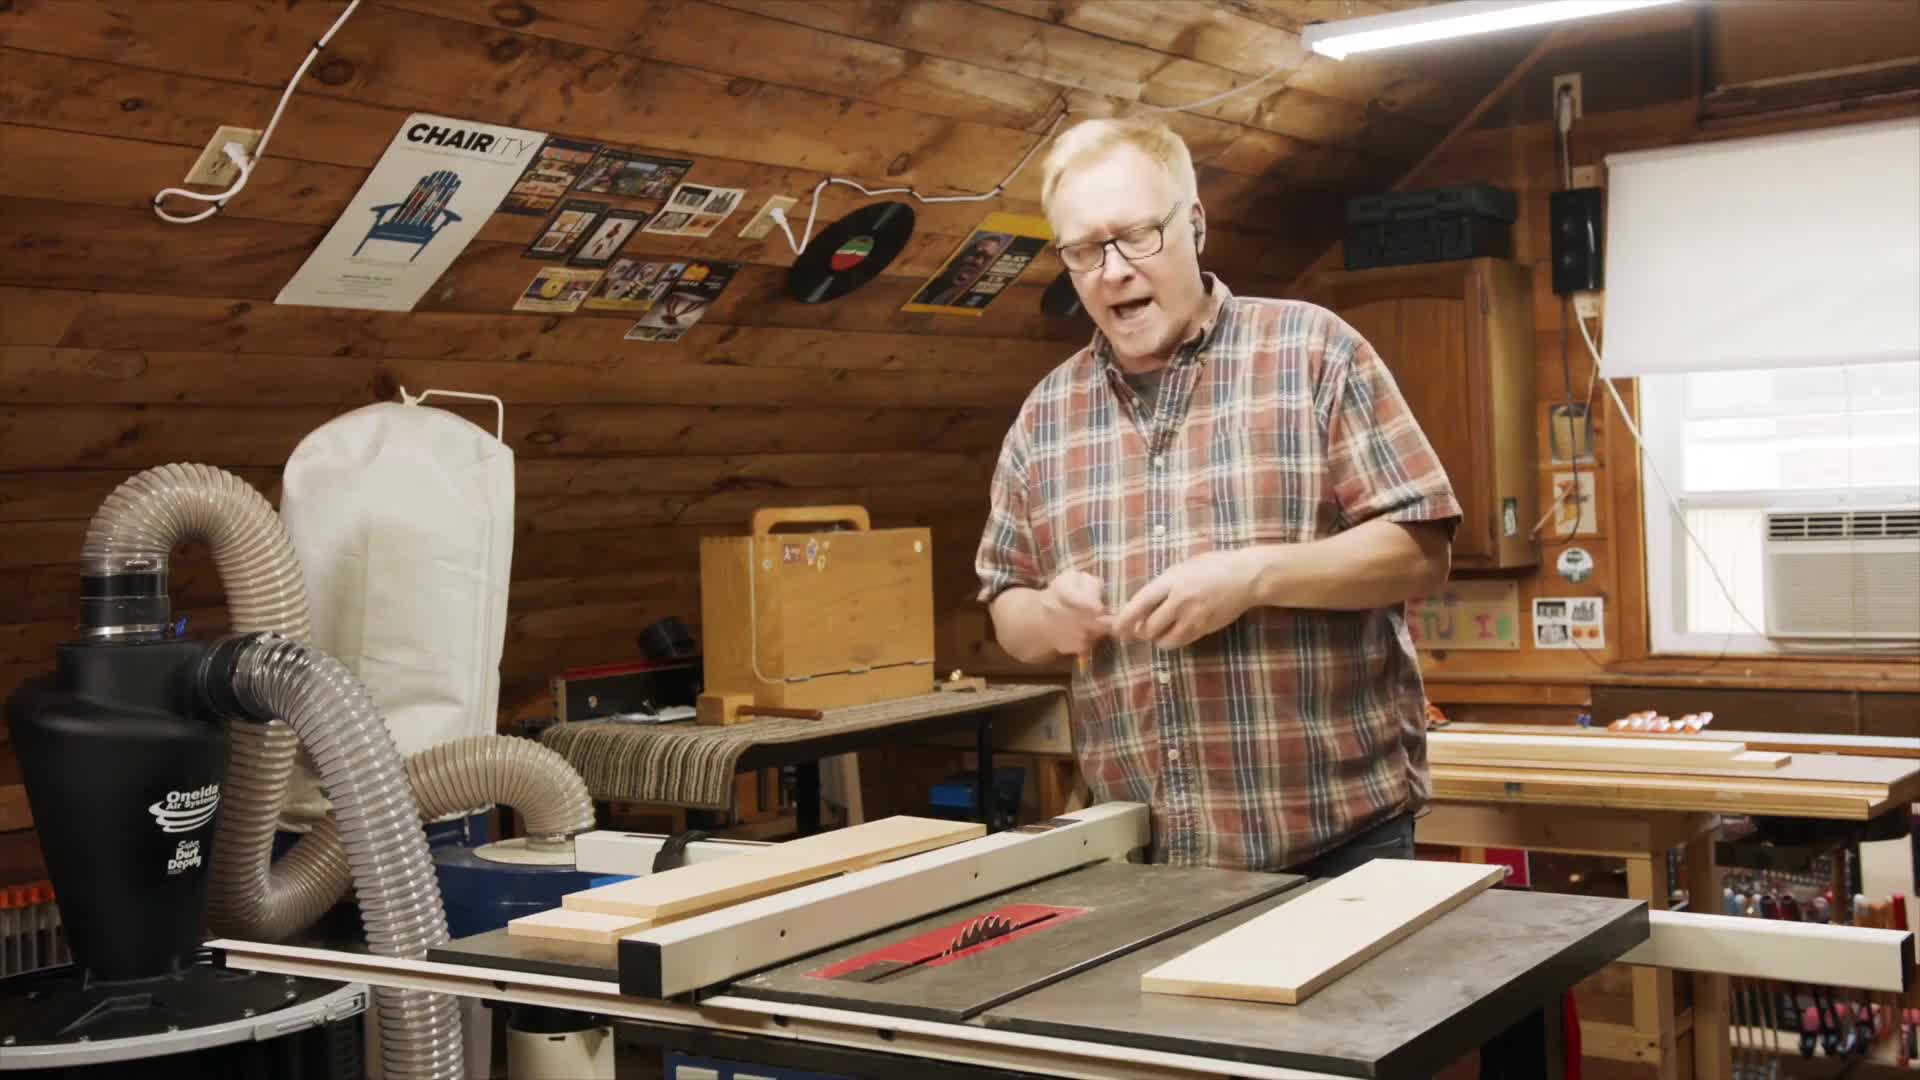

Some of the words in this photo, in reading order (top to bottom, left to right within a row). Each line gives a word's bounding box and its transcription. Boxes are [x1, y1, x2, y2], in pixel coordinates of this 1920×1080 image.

[406, 122, 537, 159] CHAIRITY
[166, 783, 219, 803] Oneida
[166, 802, 182, 810] Air
[167, 855, 202, 870] Deputy
